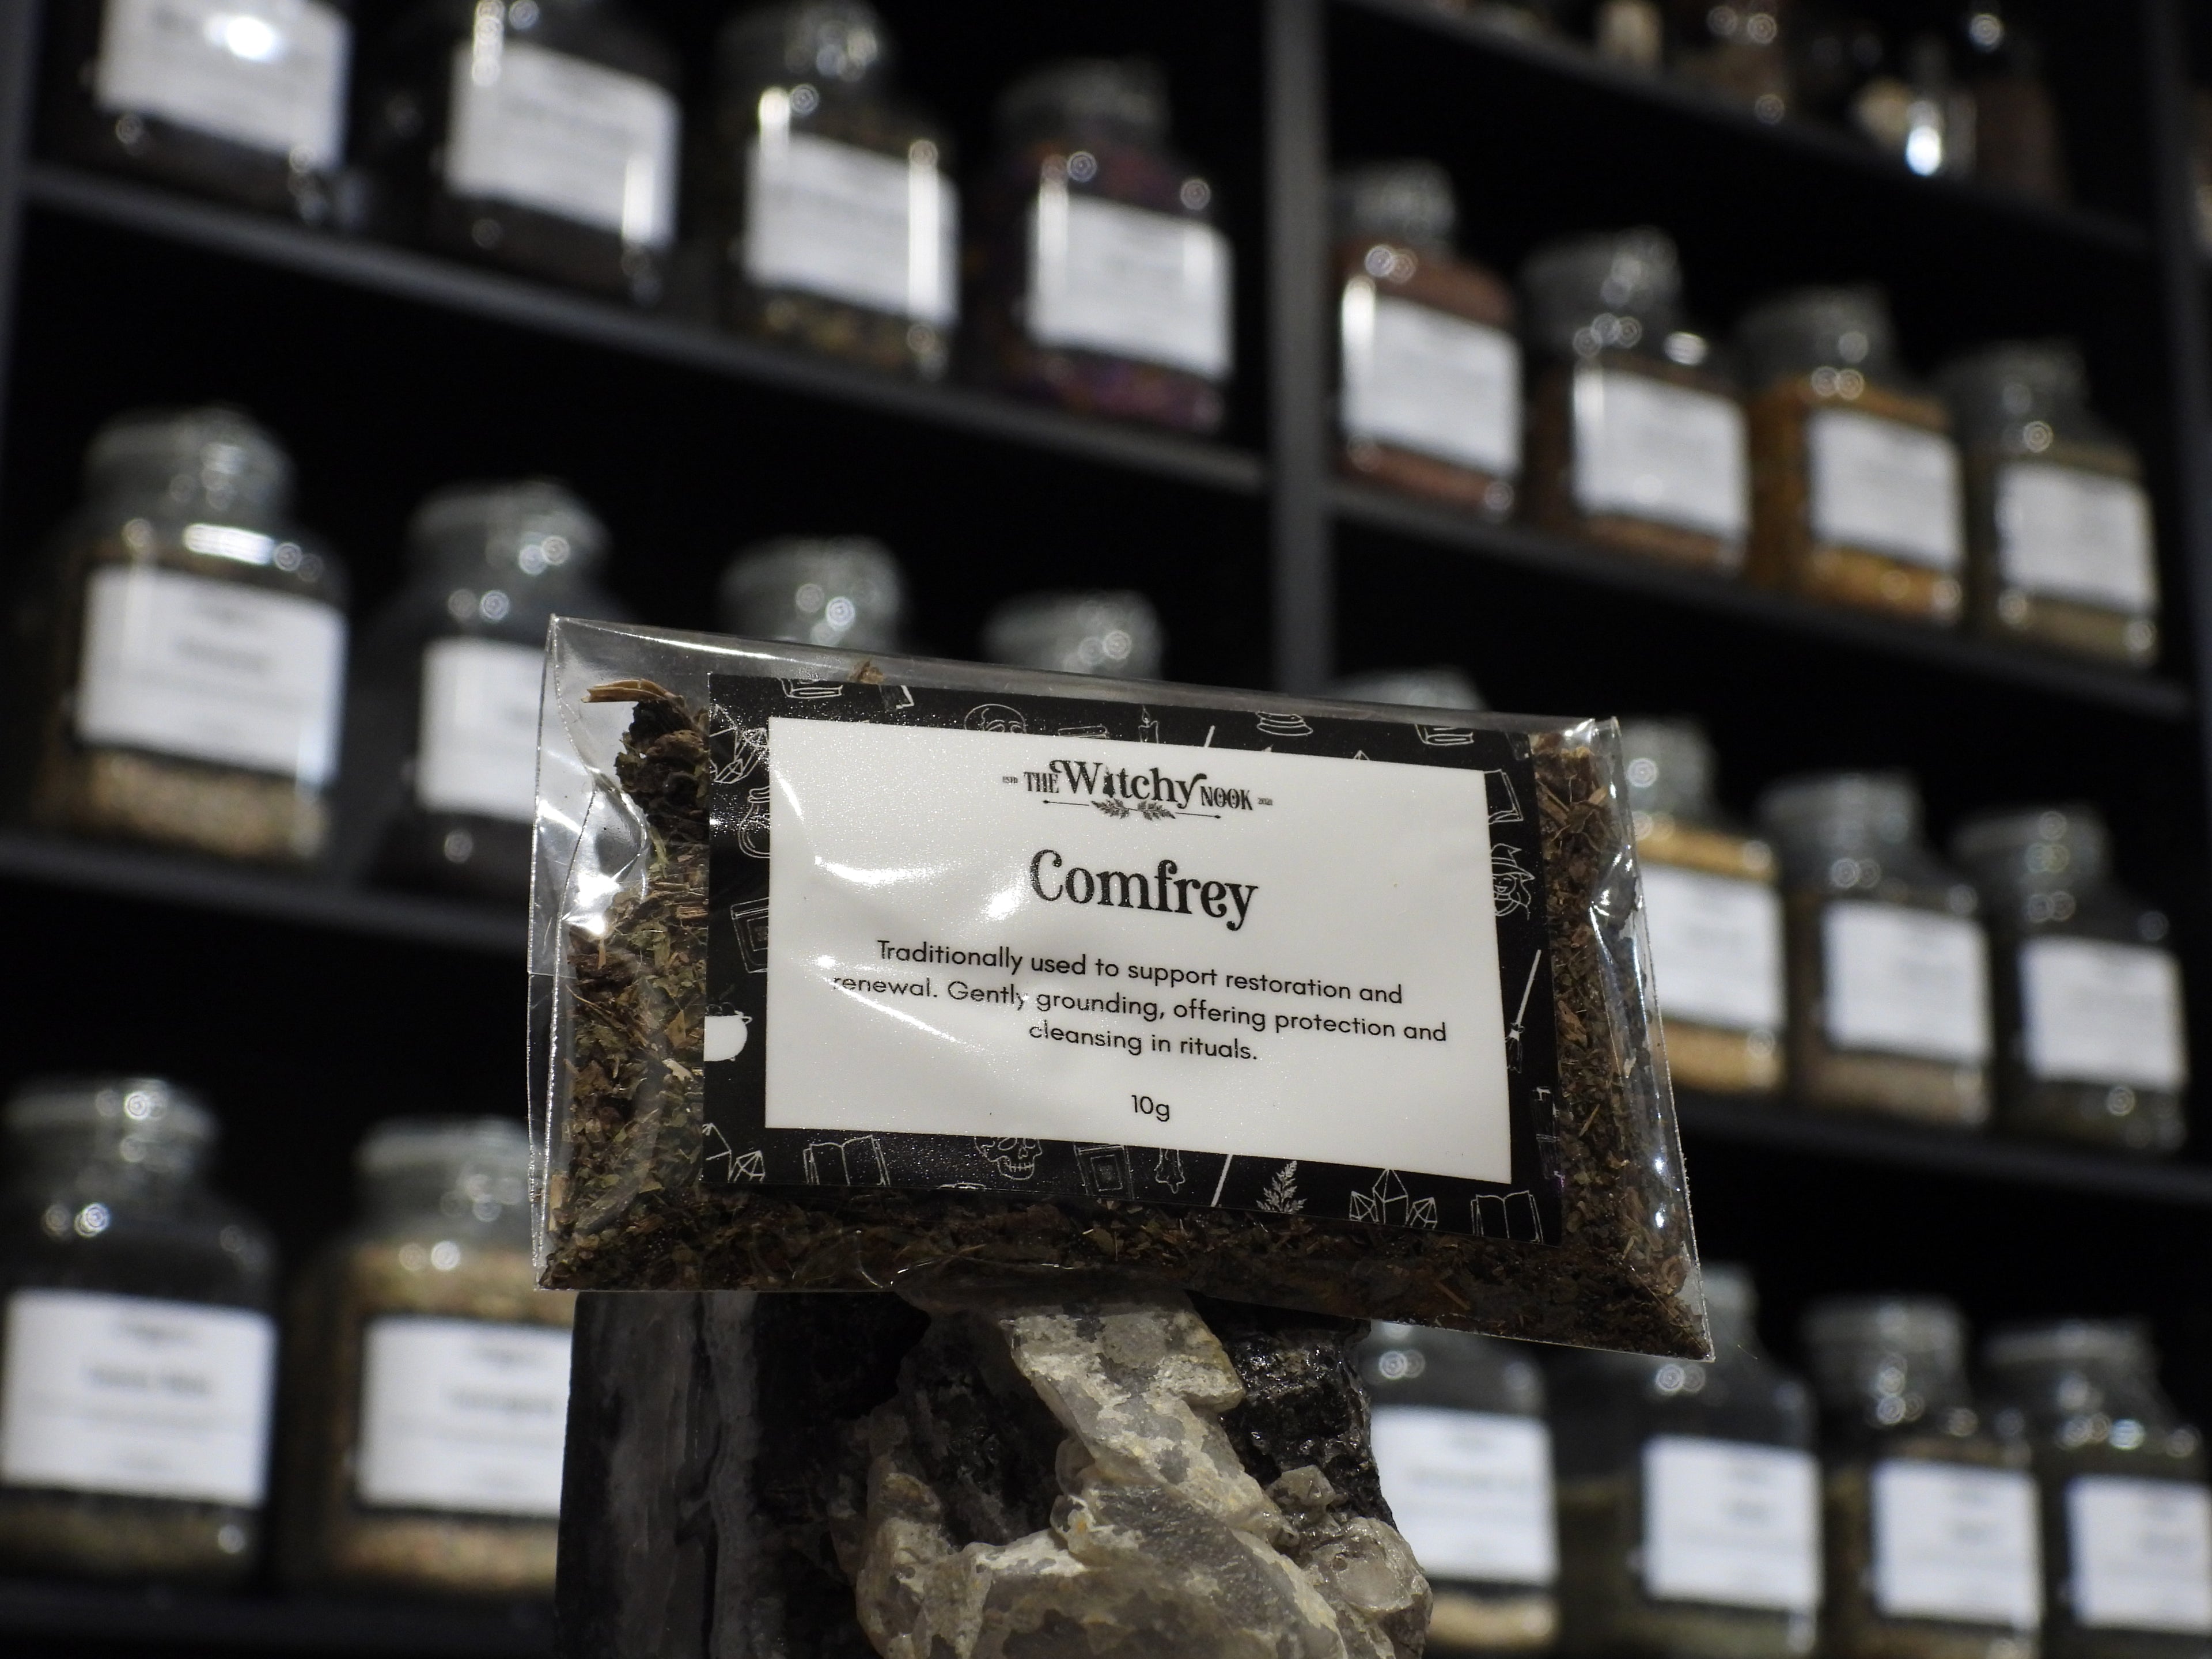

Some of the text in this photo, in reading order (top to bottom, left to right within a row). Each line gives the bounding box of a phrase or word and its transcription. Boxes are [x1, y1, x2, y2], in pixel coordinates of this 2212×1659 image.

[1024, 771, 1059, 793] THE
[1049, 759, 1207, 809] Witchy
[1200, 786, 1253, 810] NOOK
[1030, 849, 1258, 931] Comfrey
[877, 940, 1402, 1004] Traditionally used to support restoration and
[834, 977, 1447, 1042] renewal. Gently grounding, offering protection and
[1029, 1020, 1257, 1060] cleansing in rituals.
[1131, 1095, 1170, 1122] 10g
